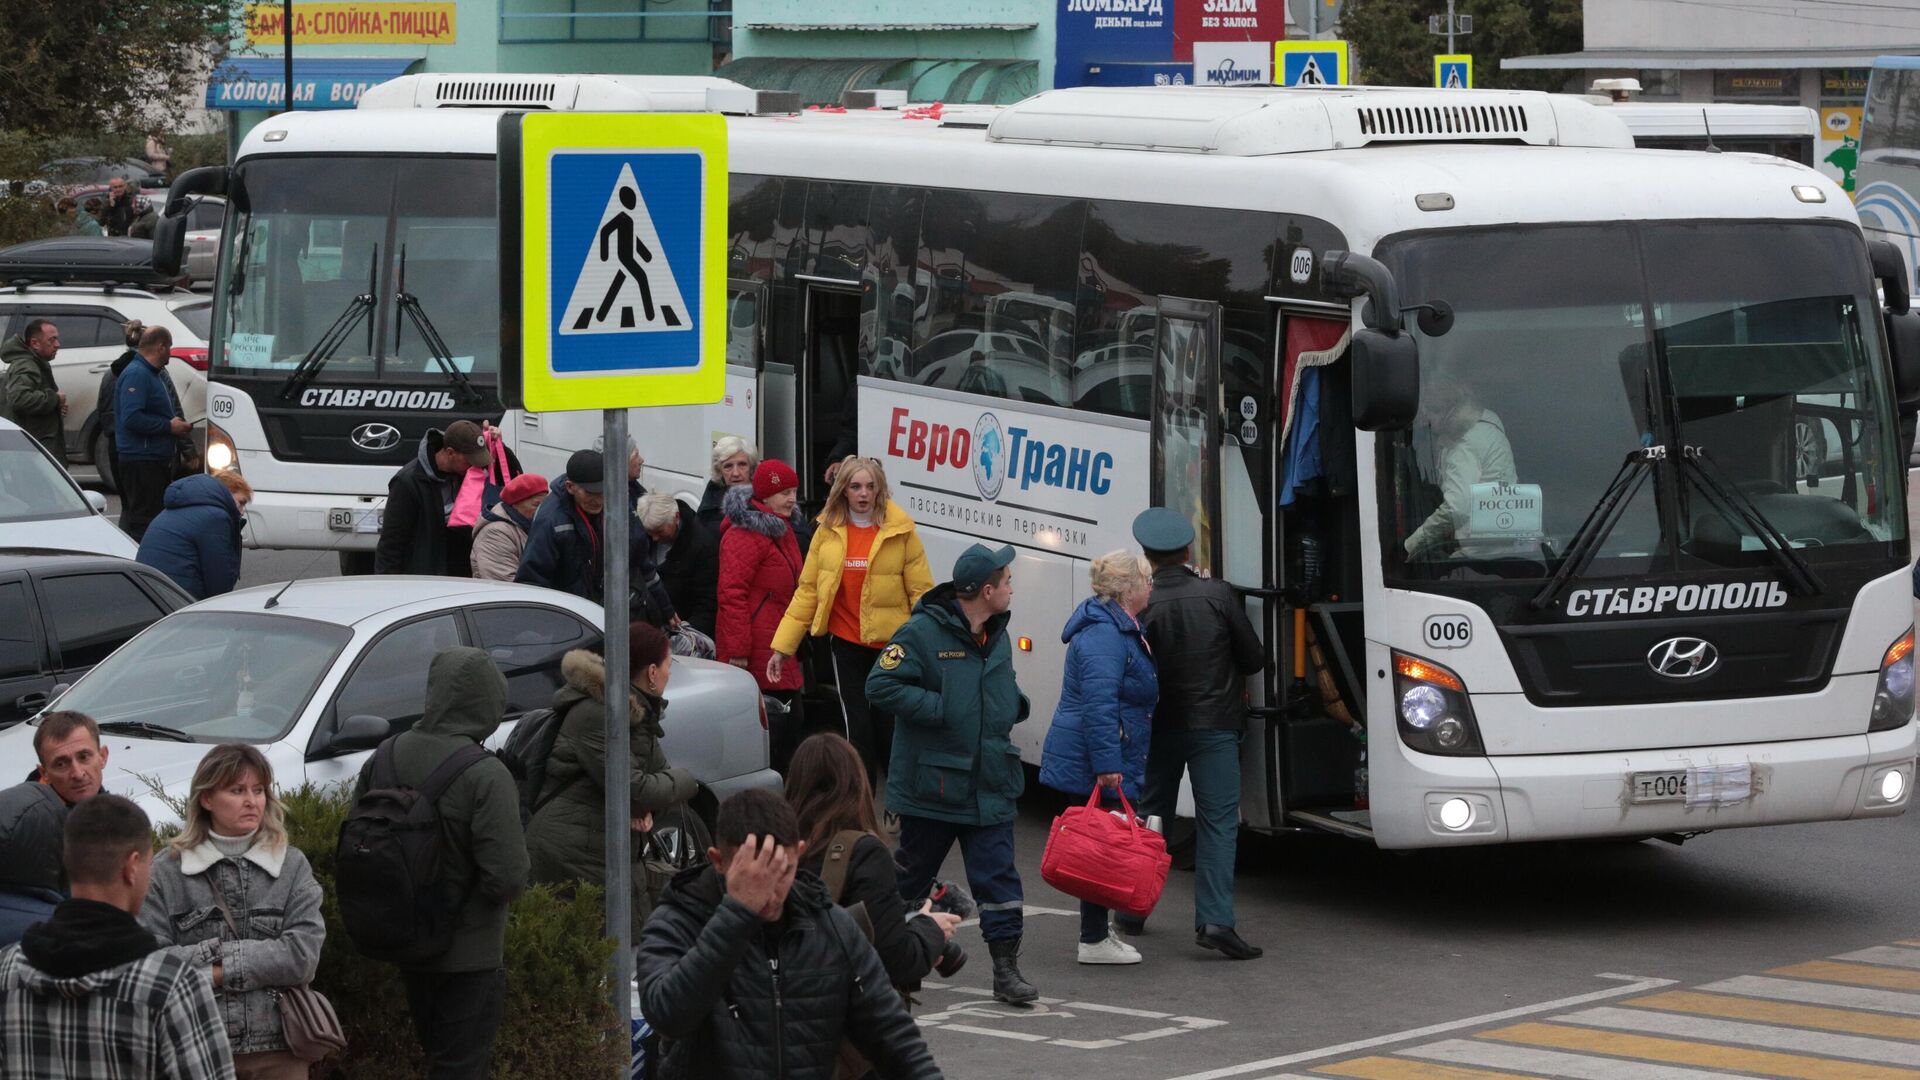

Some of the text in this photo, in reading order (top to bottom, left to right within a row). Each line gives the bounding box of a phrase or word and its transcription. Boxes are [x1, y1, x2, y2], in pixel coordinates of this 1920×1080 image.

[250, 8, 450, 38] САМА СЛОЙКА ПИЦЦА
[1095, 17, 1132, 29] ДЕНЬГИ
[1202, 17, 1258, 27] БЕЗ ЗАЛОГА
[1207, 69, 1261, 84] MAXIMUM
[1294, 256, 1311, 274] 006
[234, 344, 267, 353] РОССИИ
[214, 400, 232, 413] 009
[300, 388, 456, 409] СТАВРОПОЛЬ
[887, 406, 1114, 496] Евро Транс
[1491, 486, 1520, 497] МЧС
[910, 496, 1003, 527] пассажирские
[1479, 498, 1534, 511] РОССИИ
[1566, 581, 1788, 617] СТАВРОПОЛЬ
[1429, 621, 1469, 641] 006
